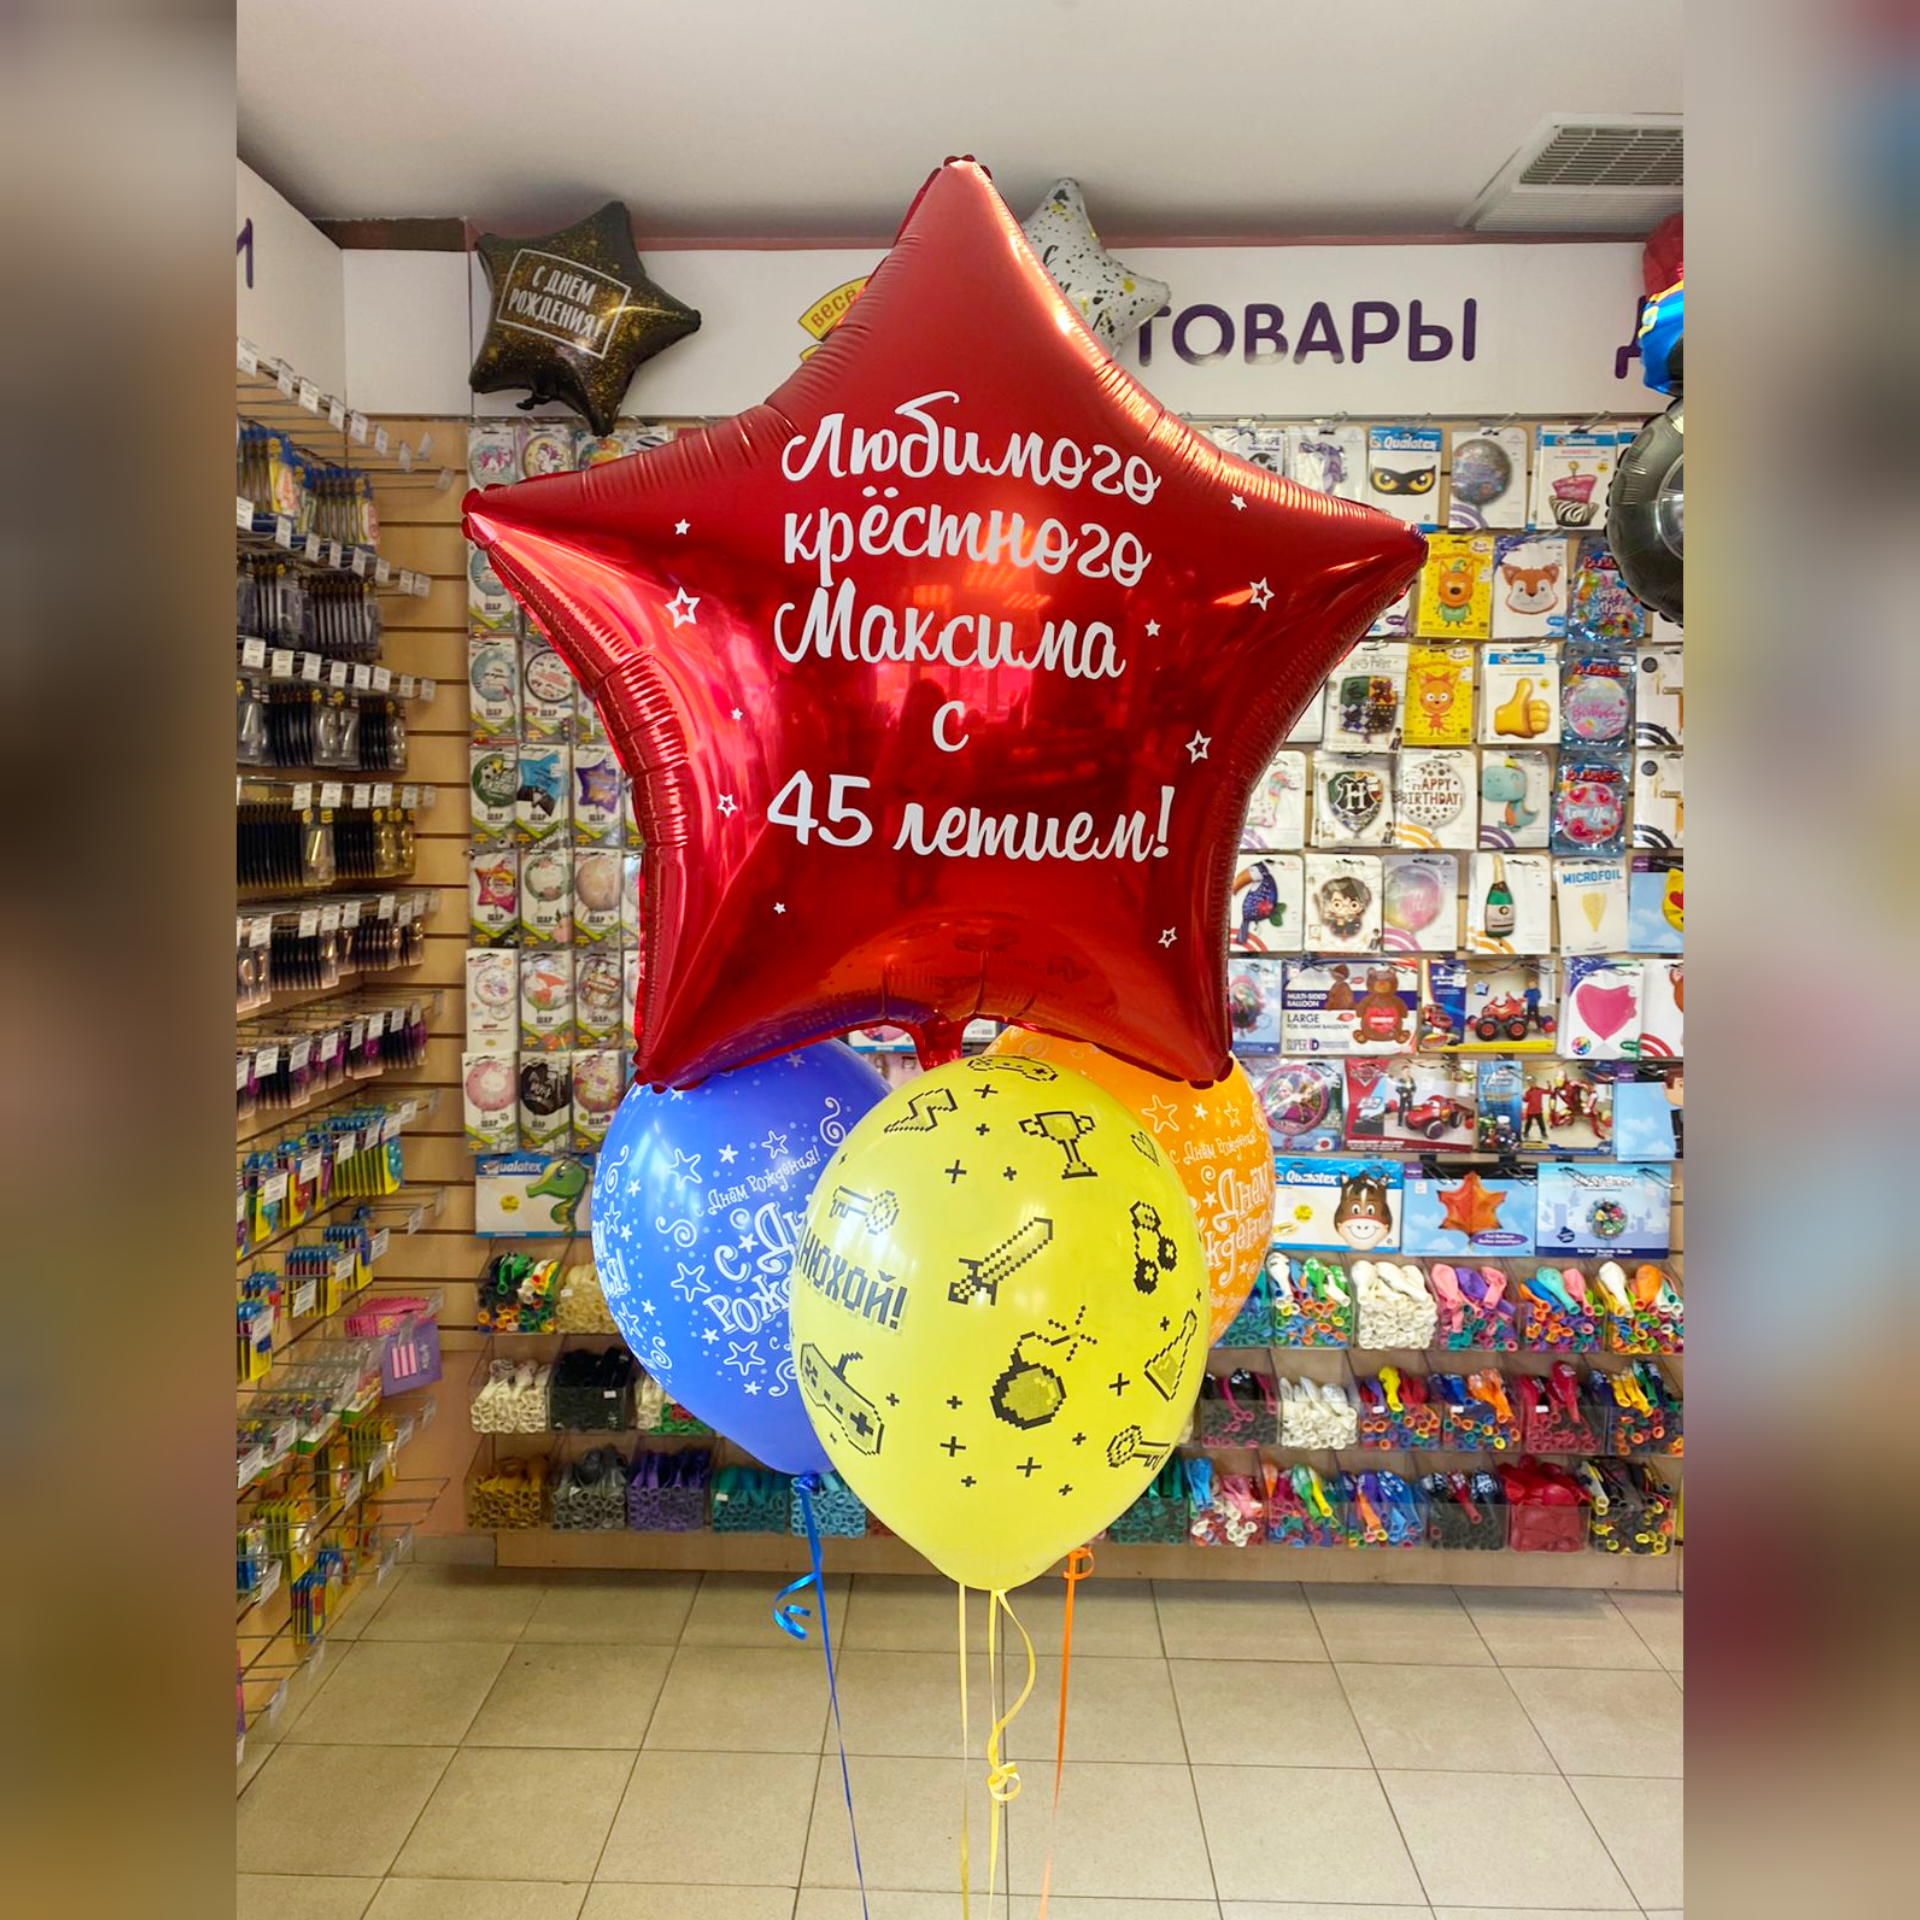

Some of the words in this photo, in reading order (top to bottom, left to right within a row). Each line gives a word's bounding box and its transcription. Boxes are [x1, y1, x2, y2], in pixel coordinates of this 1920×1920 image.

[507, 288, 605, 340] РОЖДЕНИЯ!
[531, 265, 546, 287] С
[543, 269, 597, 307] ДНЁМ
[810, 285, 857, 328] весё
[1139, 297, 1477, 368] ТОВАРЫ
[781, 390, 1162, 505] Любимого
[784, 485, 1152, 587] крёстного
[773, 577, 1126, 680] Максима
[766, 769, 873, 848] 45
[892, 785, 1176, 862] летием!
[1563, 869, 1622, 885] MICROFOIL
[1287, 1013, 1320, 1023] LARGE
[499, 1160, 542, 1174] ualatex
[707, 1183, 751, 1216] Днём
[745, 1144, 821, 1192] Рождения!
[754, 1201, 806, 1276] Дн
[799, 1227, 908, 1330] НЮХОЙ!
